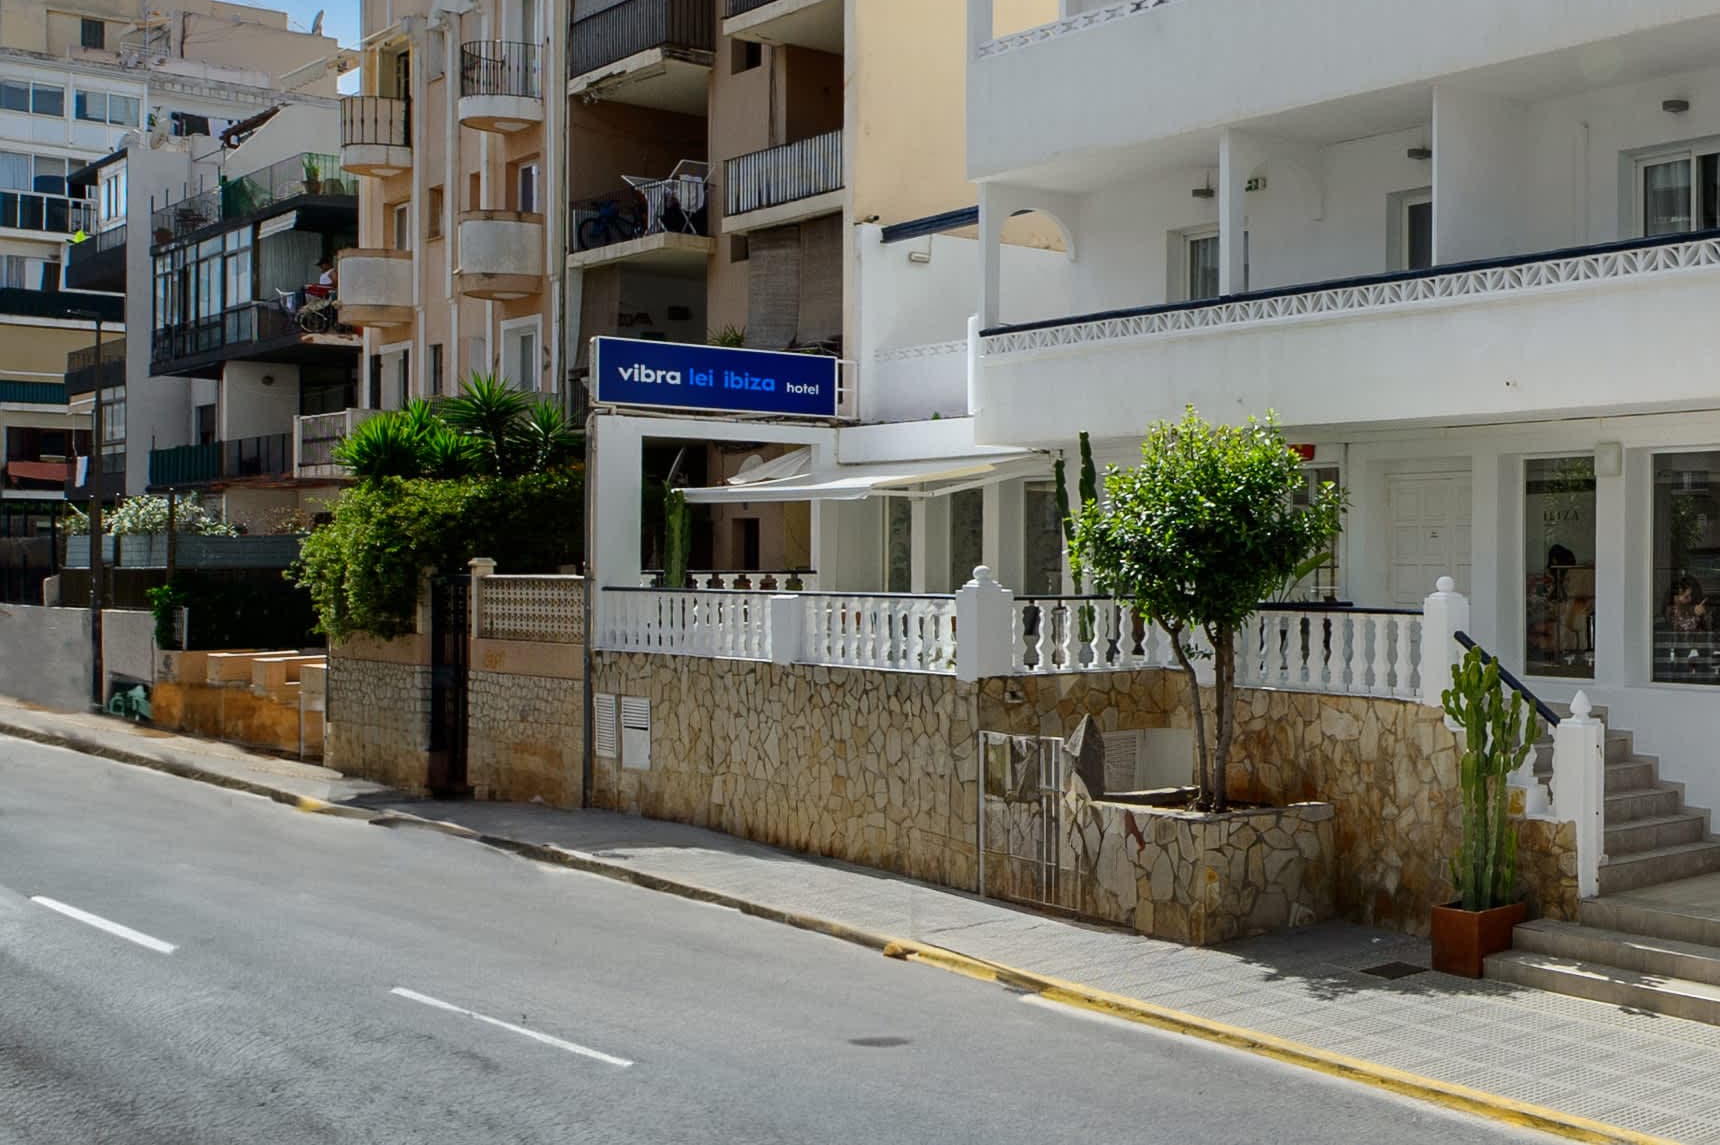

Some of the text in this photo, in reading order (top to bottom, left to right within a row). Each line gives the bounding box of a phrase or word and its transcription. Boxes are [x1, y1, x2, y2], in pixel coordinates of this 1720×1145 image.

[617, 364, 819, 395] vibra lei ibiza hotel
